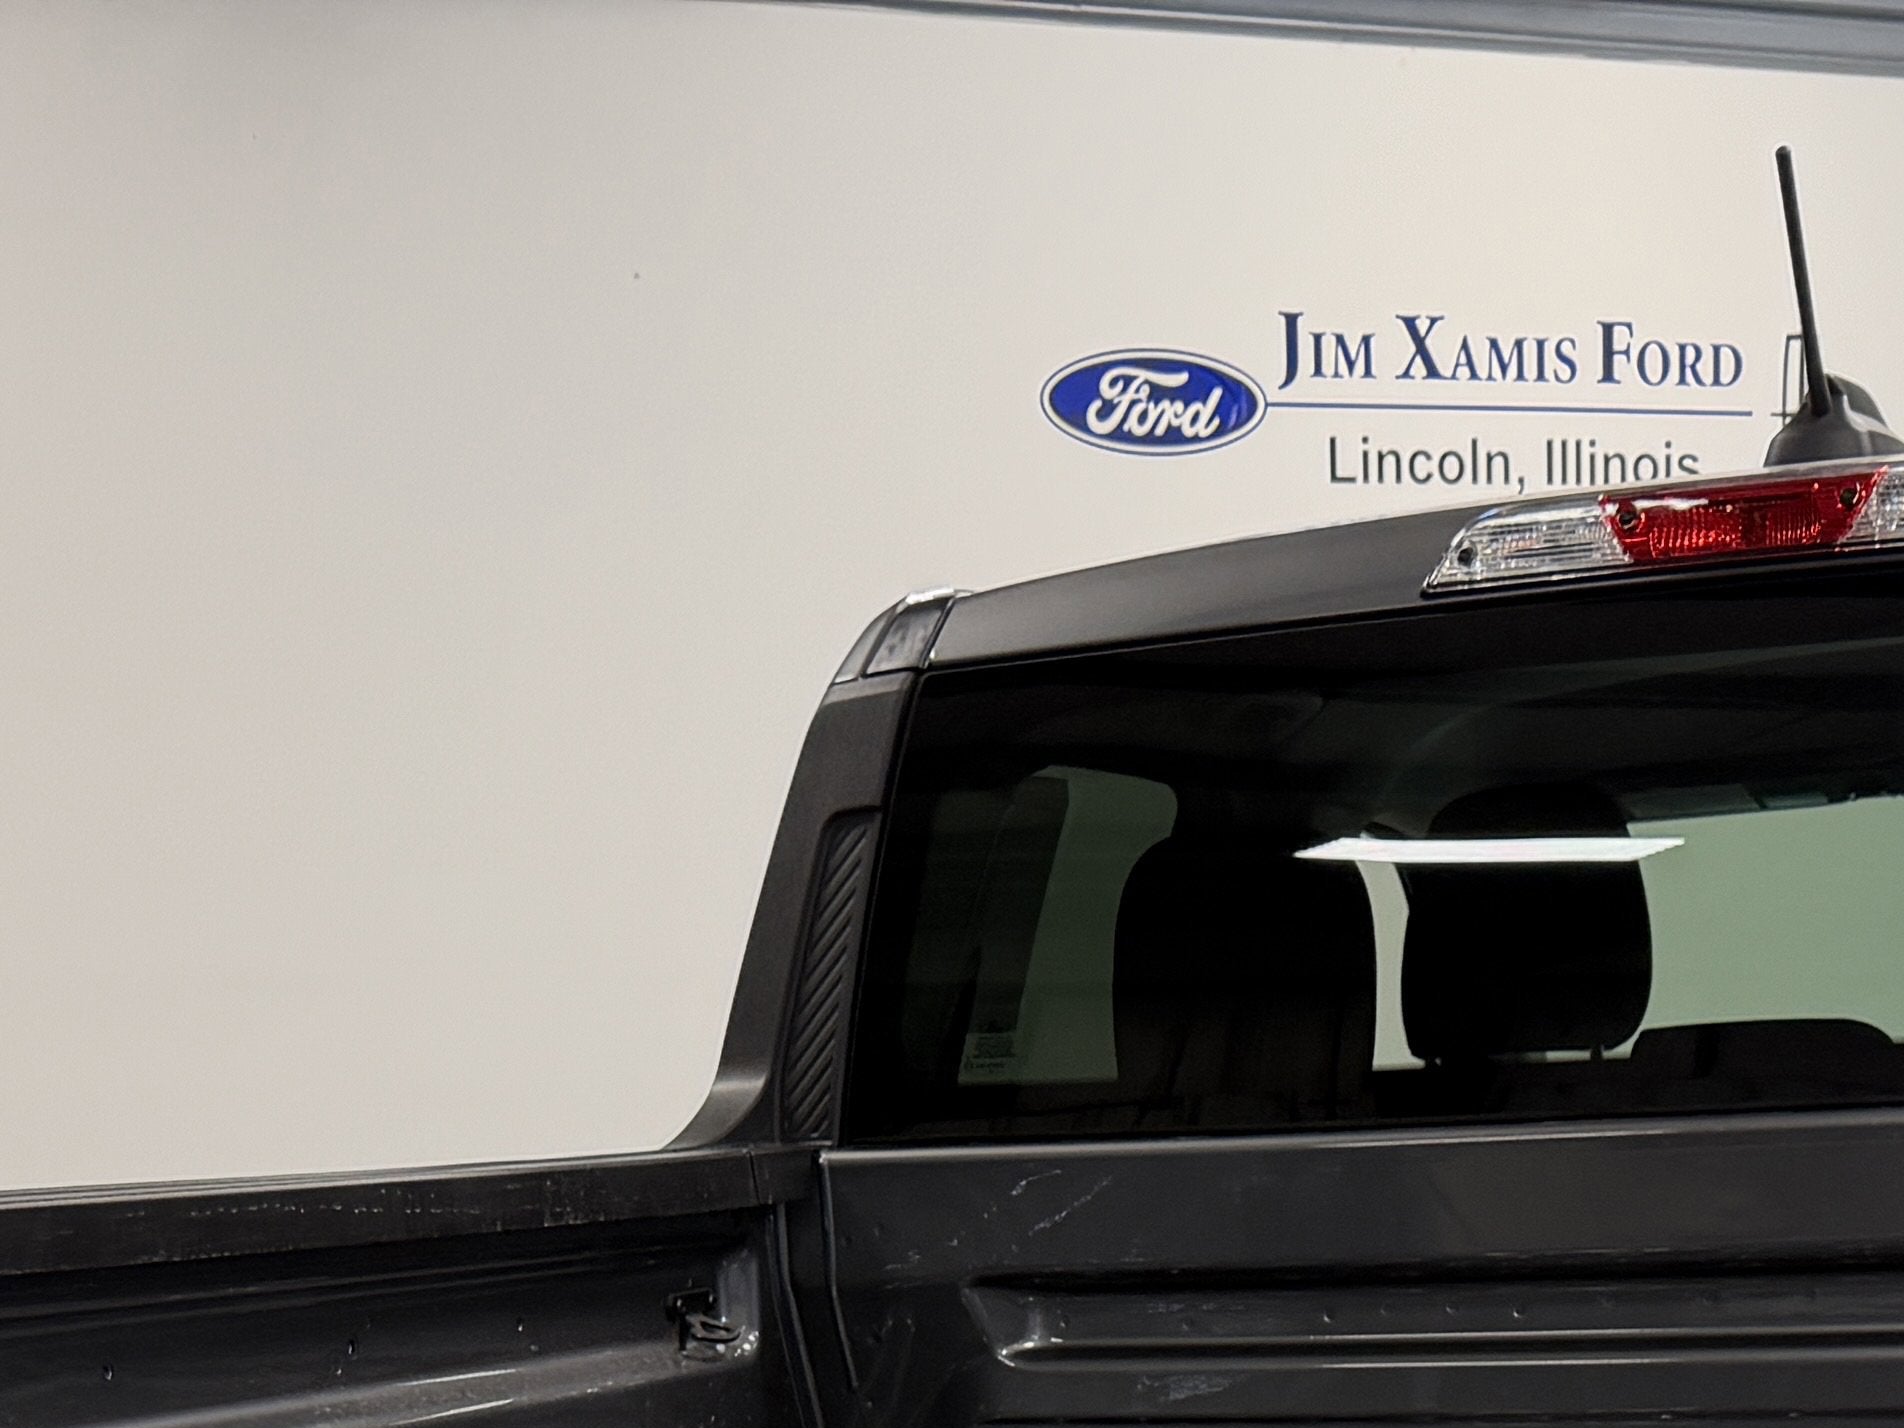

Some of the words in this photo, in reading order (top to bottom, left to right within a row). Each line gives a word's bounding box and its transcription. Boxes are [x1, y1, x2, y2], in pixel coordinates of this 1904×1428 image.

[1278, 311, 1376, 390] JIM
[1395, 315, 1577, 384] XAMIS
[1597, 321, 1742, 387] FORD
[1087, 367, 1222, 437] Ford
[1330, 436, 1524, 495] Lincoln,
[1547, 439, 1699, 486] Illinois
